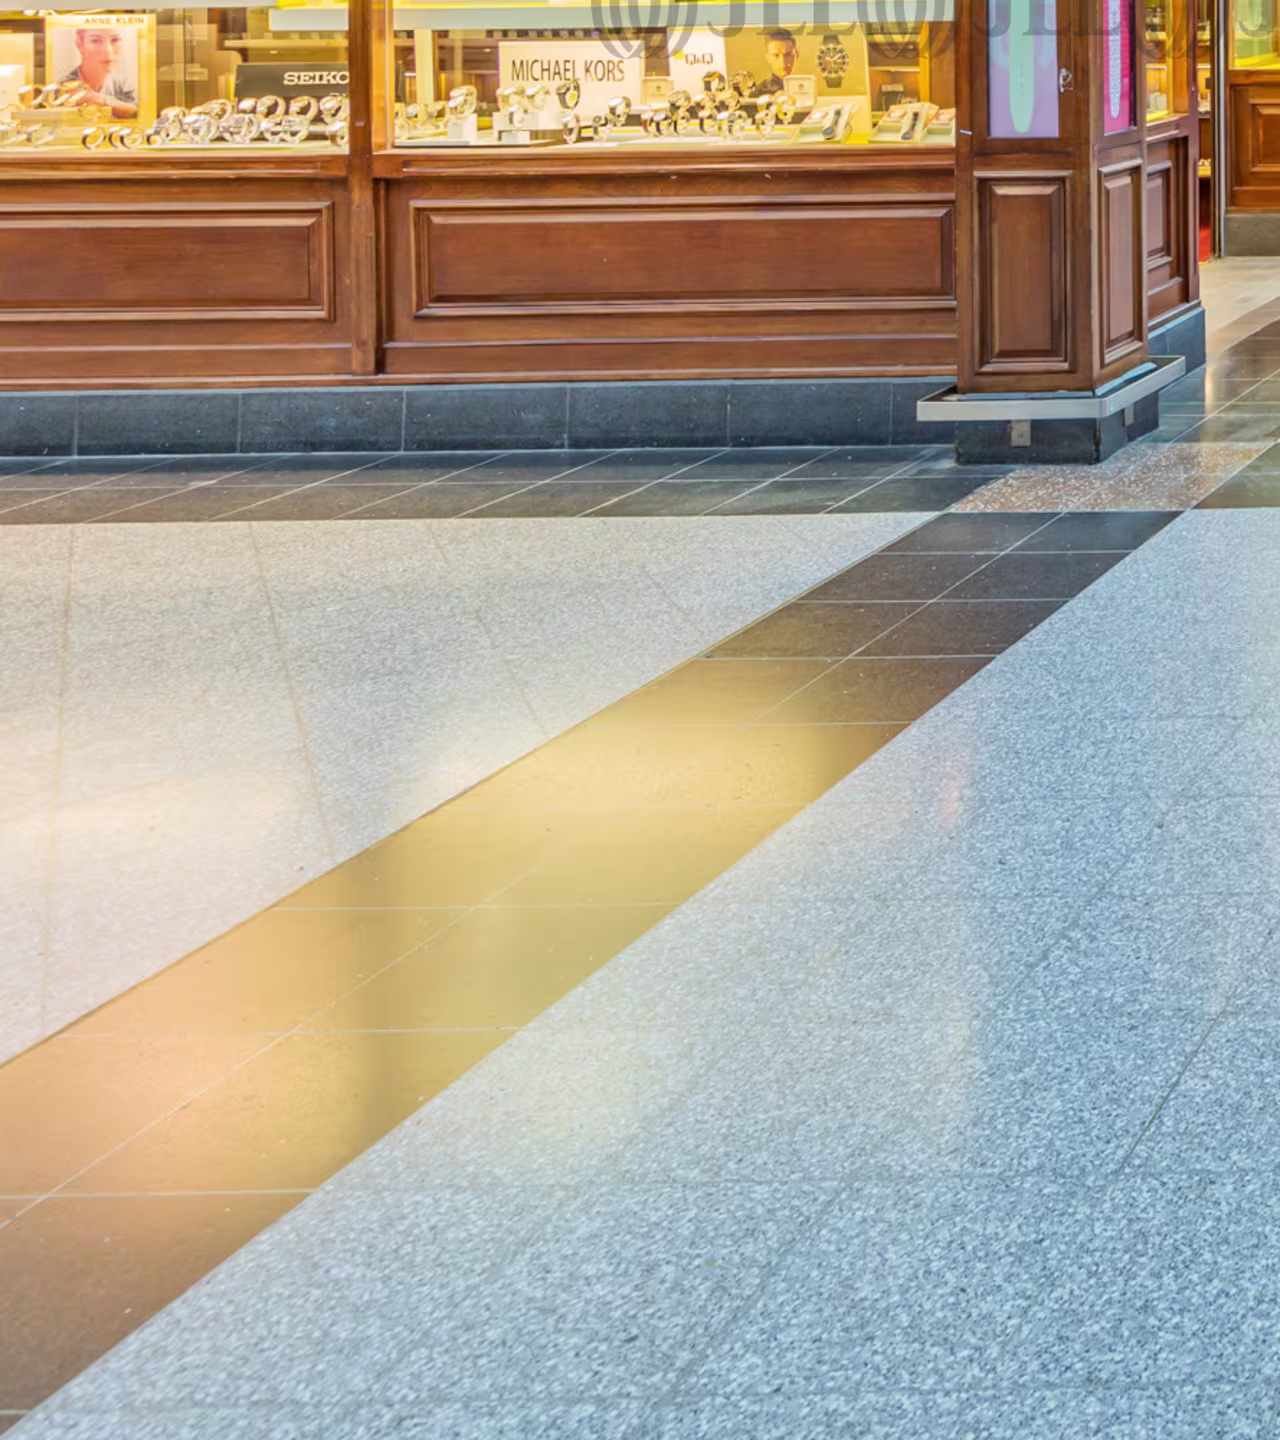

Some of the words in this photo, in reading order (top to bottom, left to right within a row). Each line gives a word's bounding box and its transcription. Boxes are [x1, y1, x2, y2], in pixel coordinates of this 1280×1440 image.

[84, 17, 112, 26] ANNE
[115, 16, 145, 25] KLEIN
[511, 59, 580, 81] MICHAEL
[584, 59, 625, 82] KORS
[283, 71, 348, 86] SEIKO
